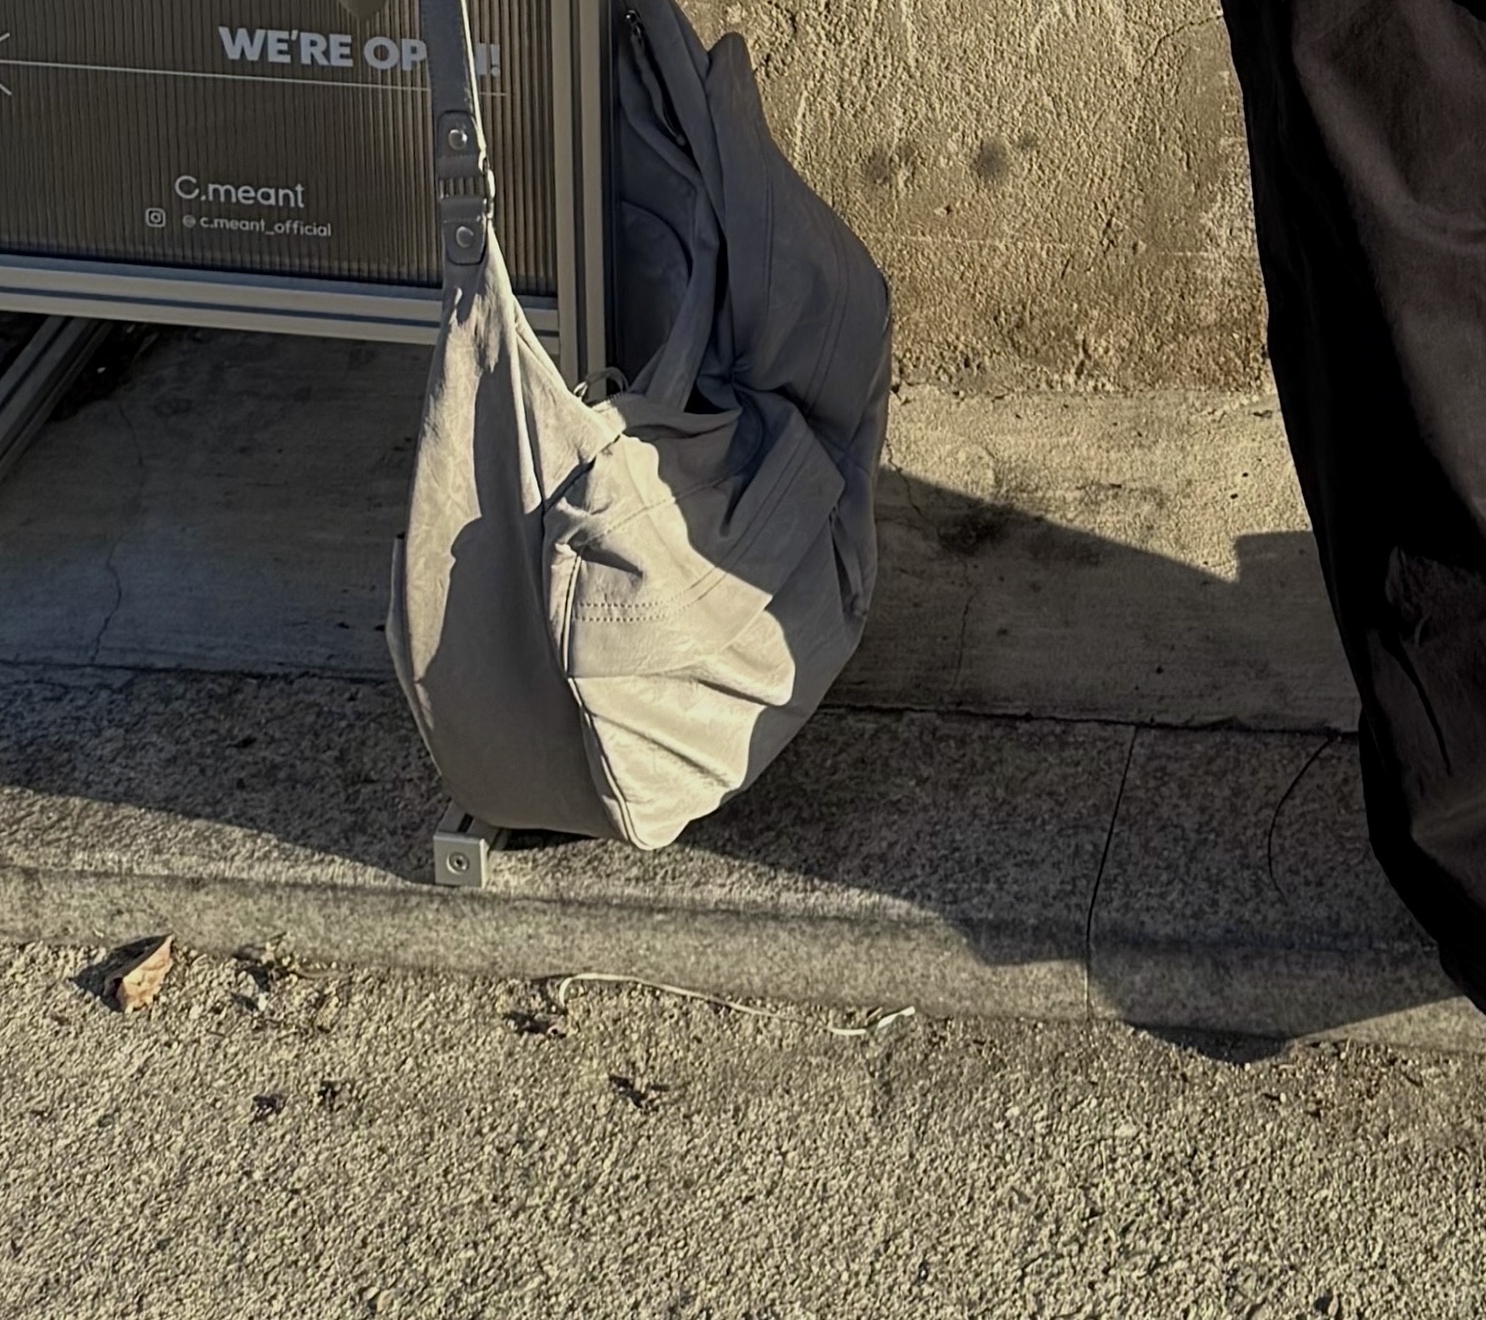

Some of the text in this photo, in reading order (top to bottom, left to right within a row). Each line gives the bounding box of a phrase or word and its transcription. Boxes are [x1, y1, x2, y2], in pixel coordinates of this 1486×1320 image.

[218, 25, 501, 77] WE'RE OP!
[174, 174, 305, 208] C.meant
[200, 216, 332, 237] c.meant_official
